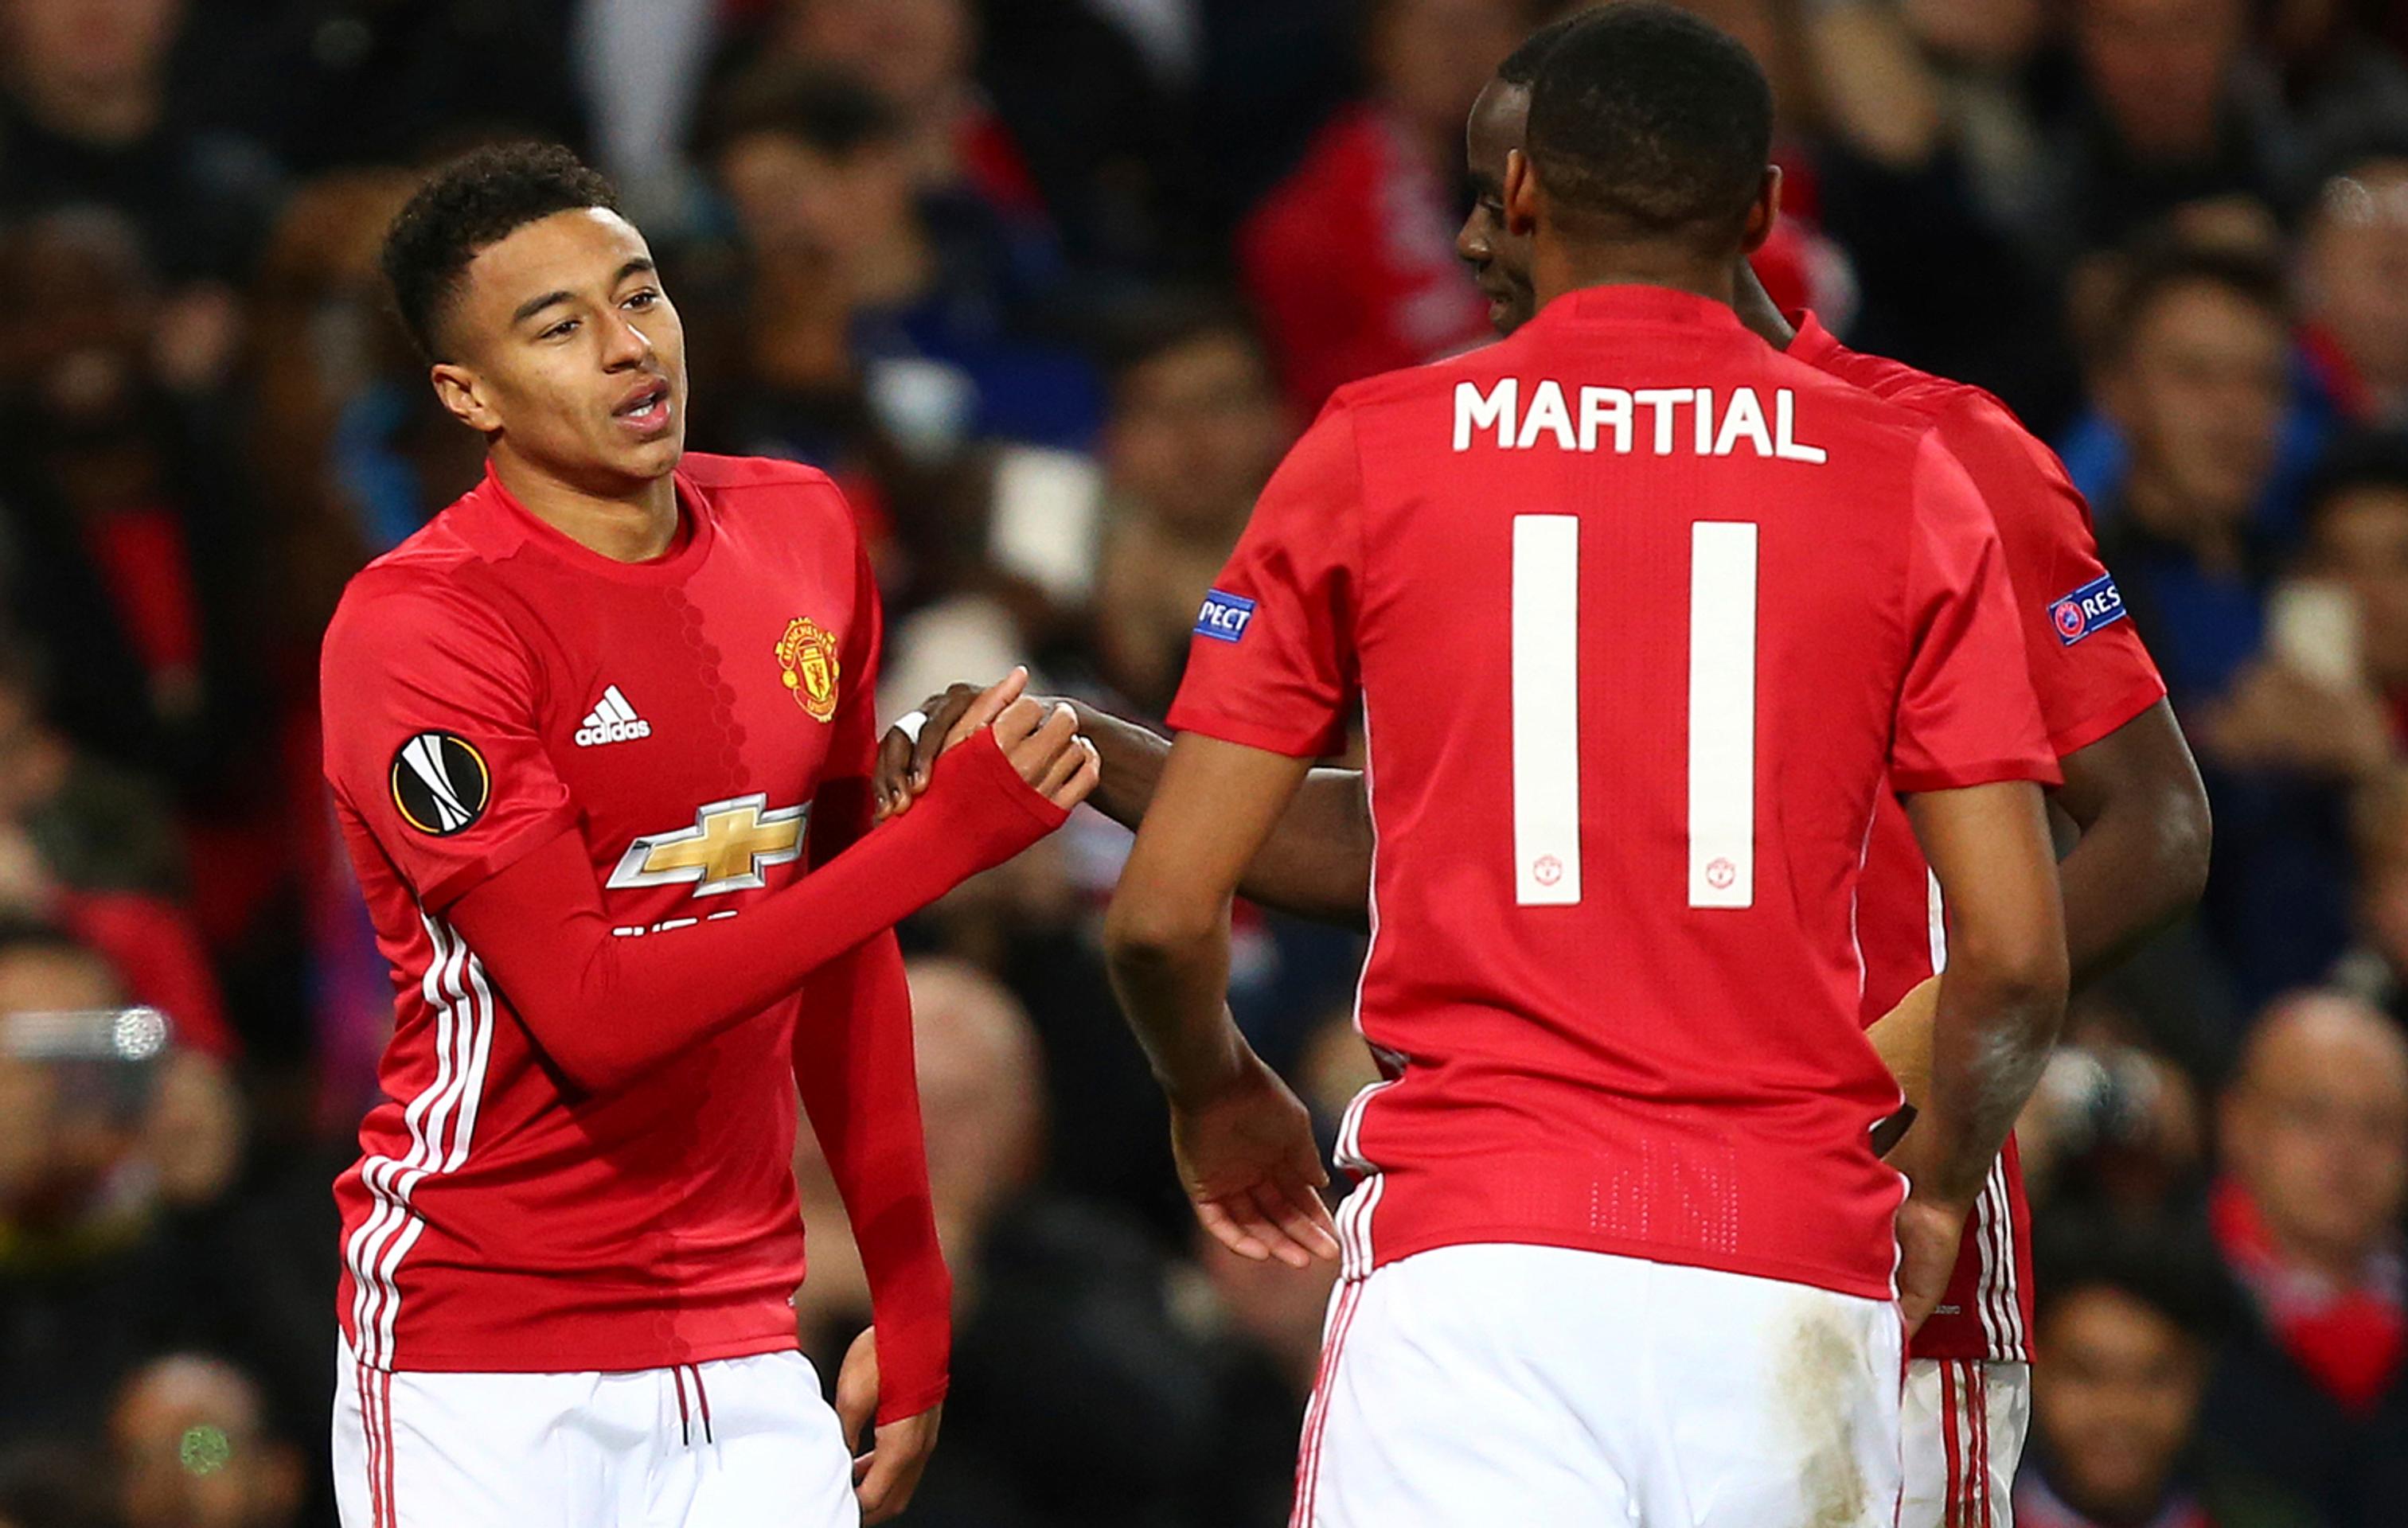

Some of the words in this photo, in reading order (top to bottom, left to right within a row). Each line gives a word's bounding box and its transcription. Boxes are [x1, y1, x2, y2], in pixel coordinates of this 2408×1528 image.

[1453, 378, 1827, 463] MARTIAL
[1199, 600, 1251, 630] PECT
[2082, 585, 2121, 619] RES
[1513, 514, 1758, 907] 11
[575, 719, 651, 746] adidas
